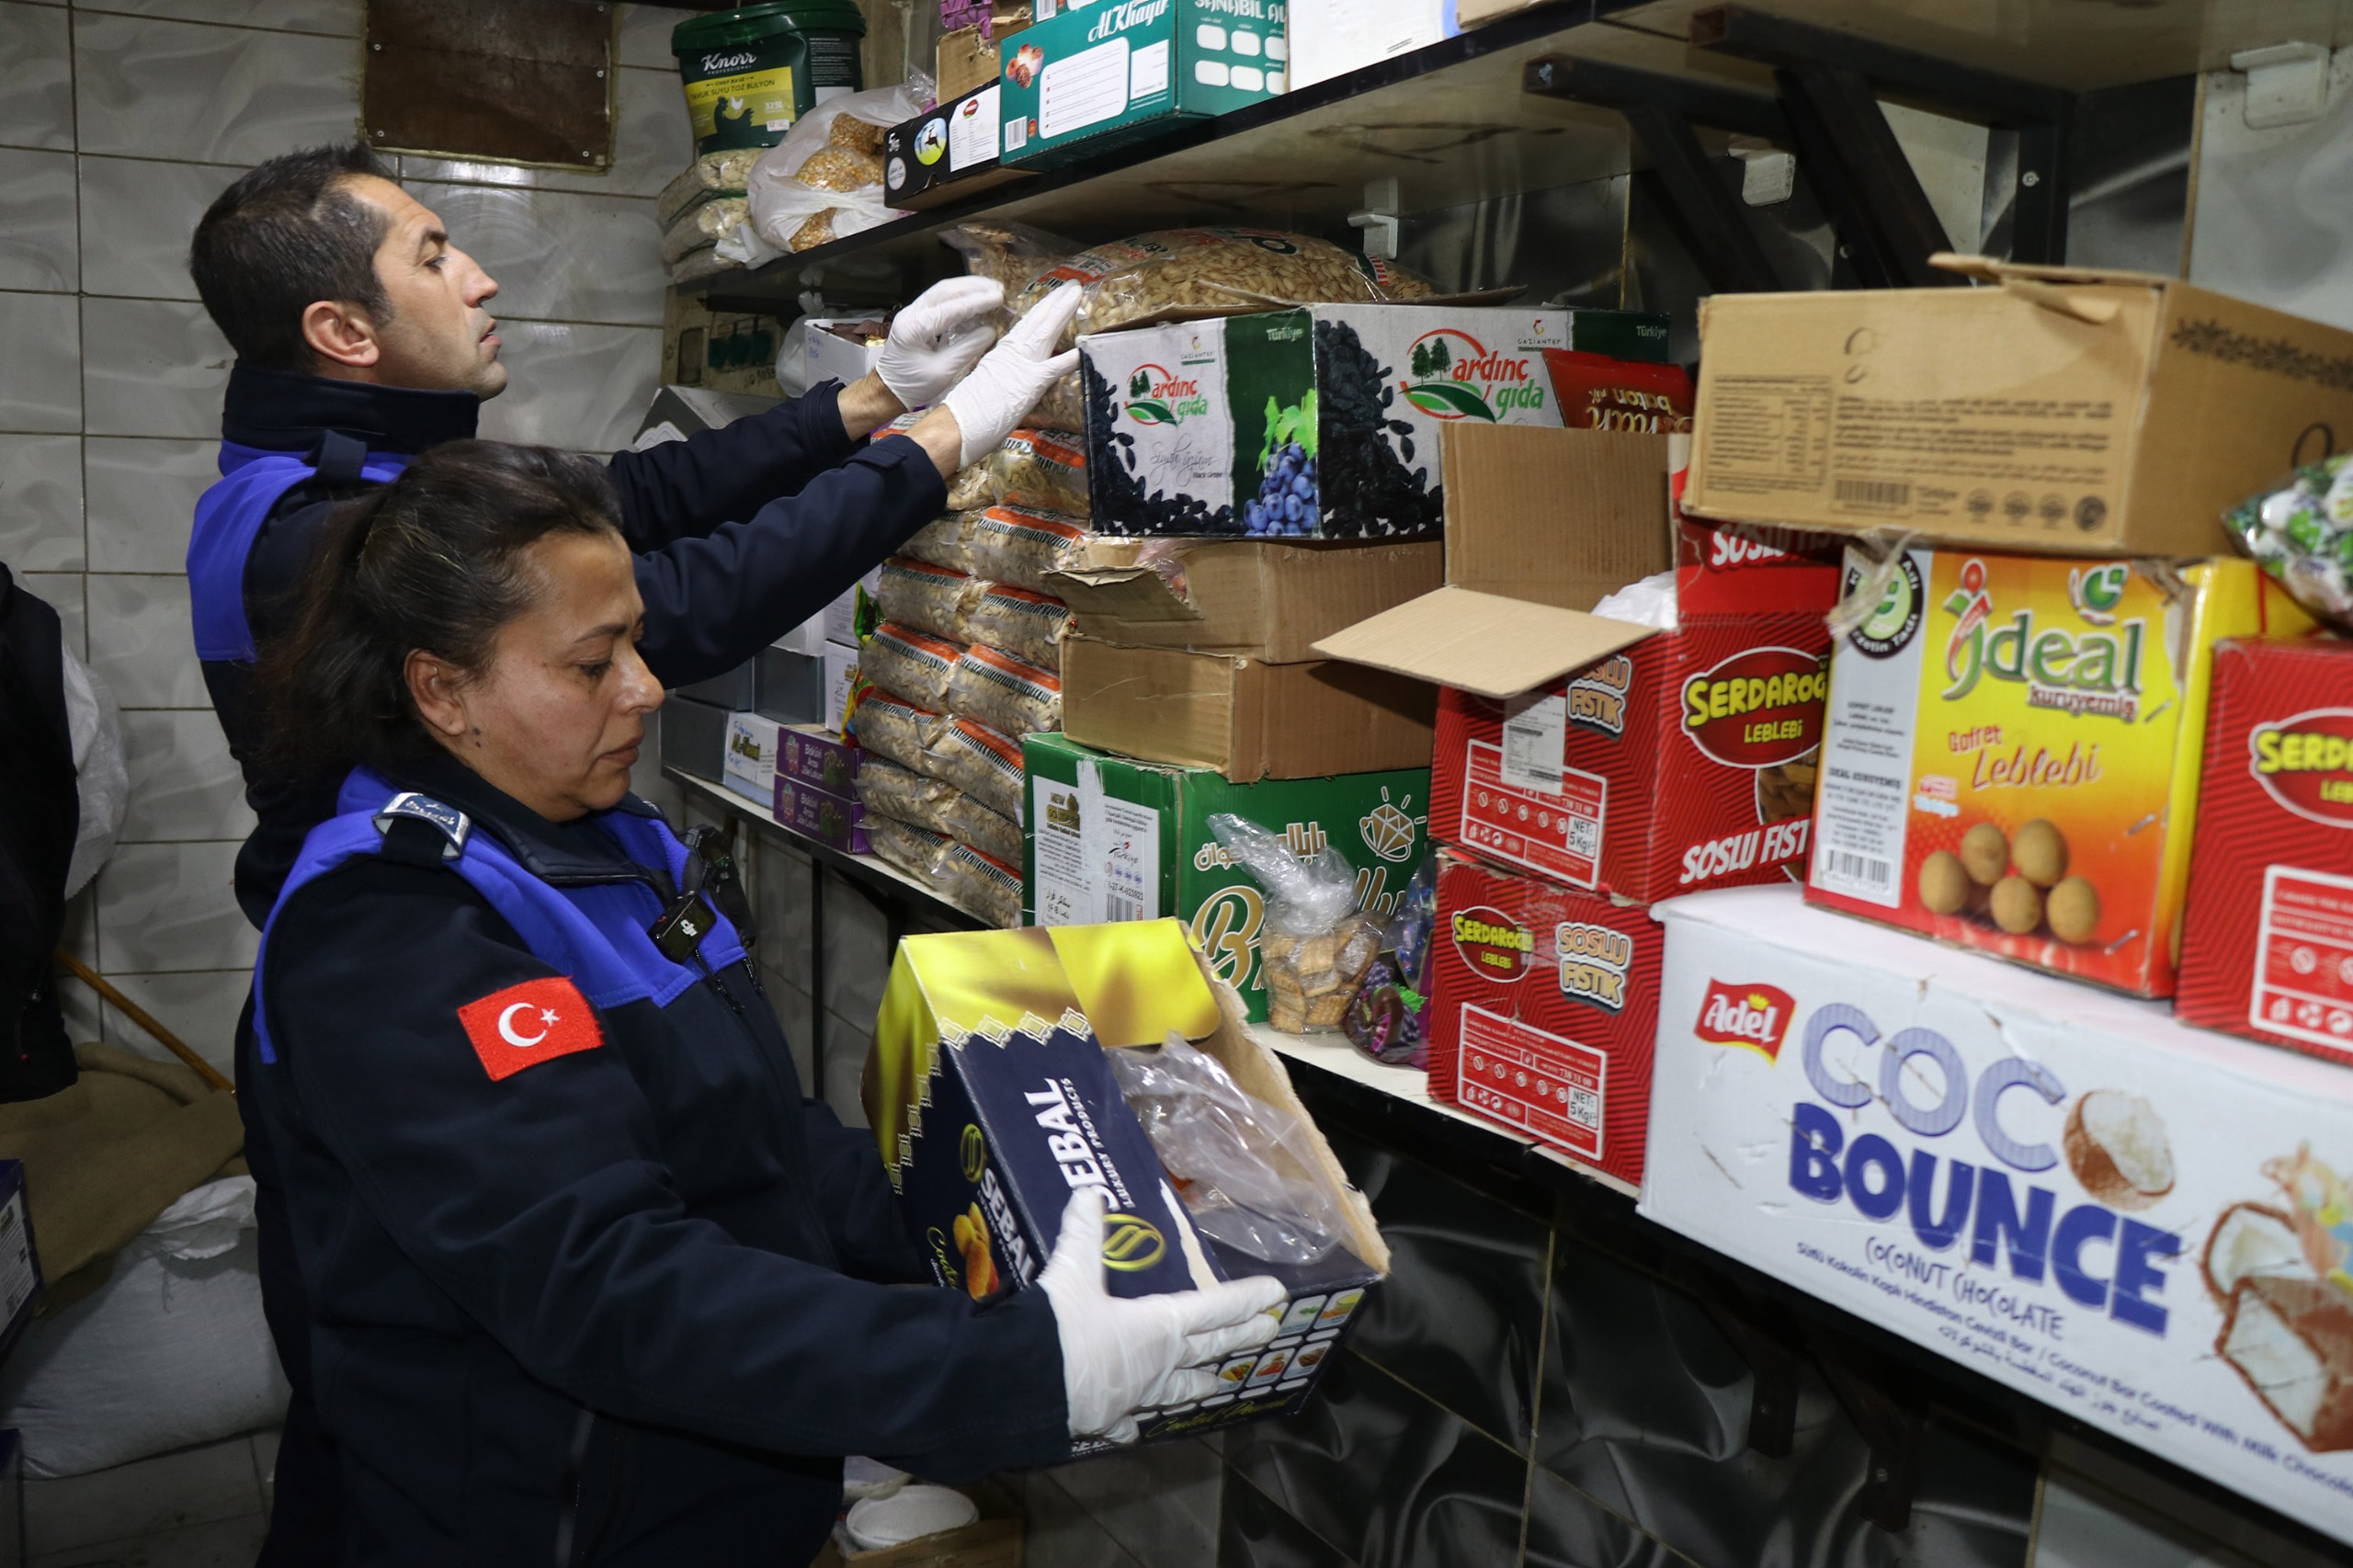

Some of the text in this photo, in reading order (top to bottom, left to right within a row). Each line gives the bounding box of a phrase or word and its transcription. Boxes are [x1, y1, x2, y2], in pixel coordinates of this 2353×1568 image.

[701, 52, 756, 71] Knorr
[707, 64, 752, 74] PROFESSIONAL
[710, 86, 730, 96] SUYU
[732, 84, 745, 93] TOZ
[746, 79, 776, 90] BULYON
[1267, 327, 1303, 342] Türkiye
[1636, 325, 1667, 340] Türkiye
[1688, 661, 1827, 726] SERDAROĞ
[1949, 724, 2002, 753] Gofret
[2256, 729, 2353, 774] SERD
[1972, 741, 2102, 790] Leblebi
[1679, 818, 1813, 884] SOSLU FIST
[1560, 926, 1626, 965] SOSLU
[1563, 963, 1621, 1003] FISTIK
[1704, 994, 1779, 1042] Adel
[1060, 1077, 1136, 1210] LUXURY PRODUCTS
[981, 1167, 1035, 1288] SEBAL
[1789, 1102, 2184, 1340] BOUNCE
[1865, 1236, 2065, 1341] COCONUT CHOCOLATE
[2048, 1351, 2107, 1387] Coconut
[2111, 1378, 2137, 1400] Bar
[2282, 1452, 2353, 1500] Chocola
